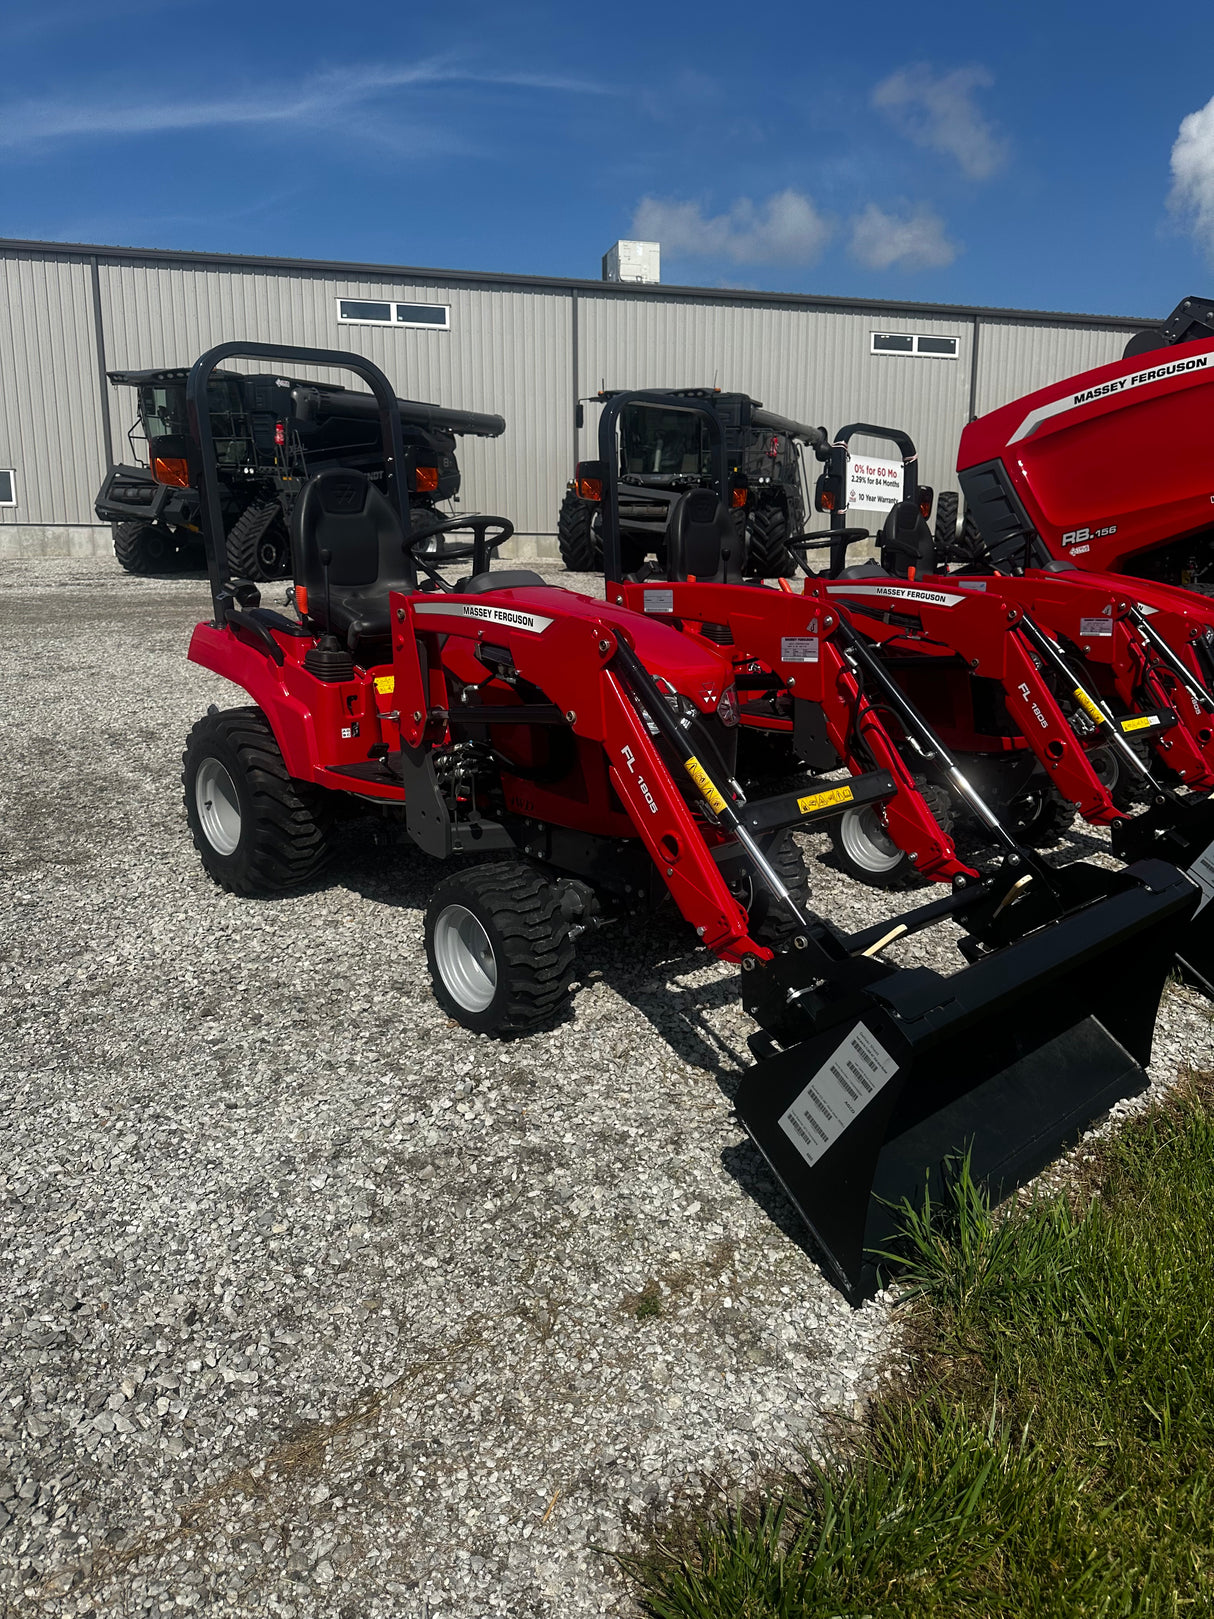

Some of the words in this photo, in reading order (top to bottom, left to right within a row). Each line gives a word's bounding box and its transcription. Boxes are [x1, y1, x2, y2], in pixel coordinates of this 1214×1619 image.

[1074, 379, 1127, 404] MASSEY
[1131, 357, 1207, 385] FERGUSON
[854, 464, 865, 474] 0%
[866, 466, 876, 476] for
[877, 467, 886, 477] 60
[888, 469, 897, 478] Mo
[851, 475, 867, 483] 2.29%
[875, 478, 882, 486] 84
[883, 479, 900, 488] Months
[858, 493, 865, 501] 10
[866, 494, 876, 502] Year
[877, 495, 899, 504] Warranty
[876, 587, 906, 597] MASSEY
[907, 590, 946, 602] FERGUSON
[463, 606, 492, 618] MASSEY
[494, 610, 534, 627] FERGUSON
[1018, 682, 1031, 702] FL
[1031, 702, 1049, 728] 1805
[620, 745, 635, 773] FL
[637, 775, 658, 814] 1805
